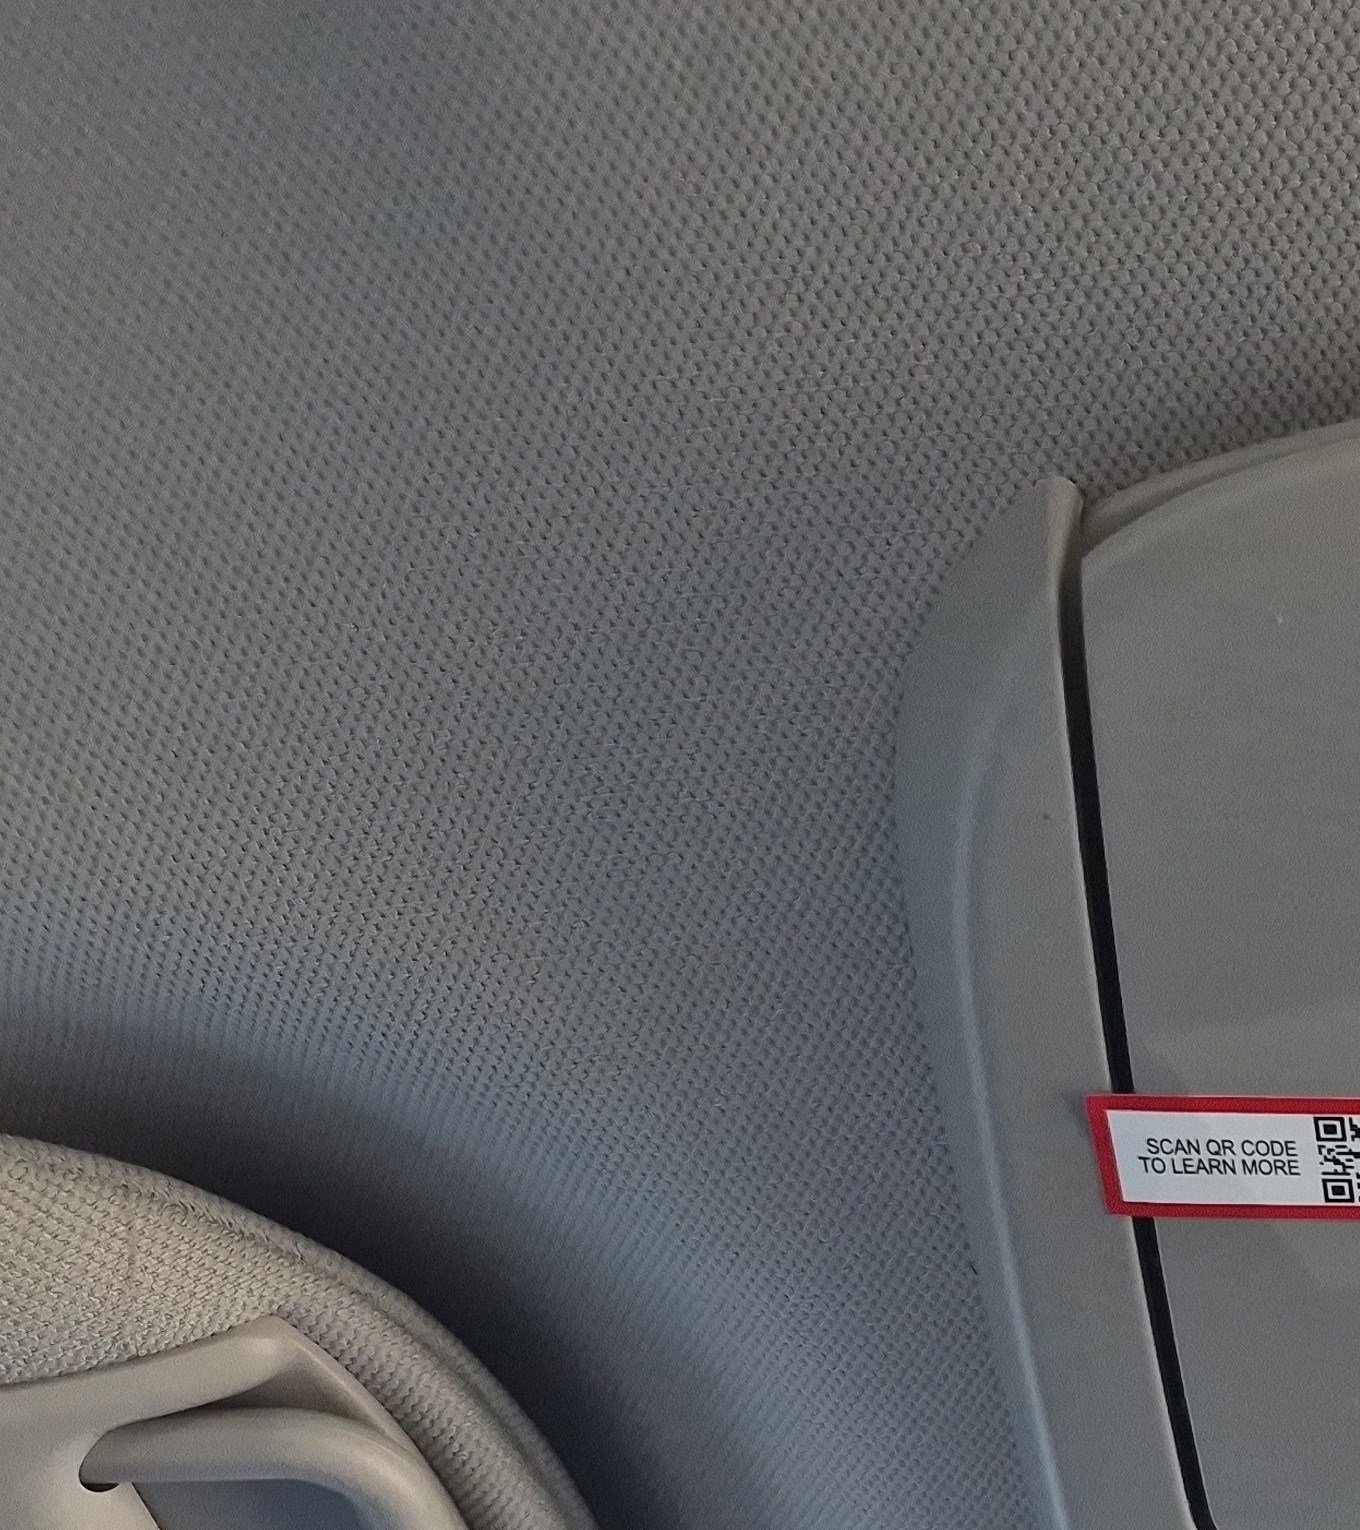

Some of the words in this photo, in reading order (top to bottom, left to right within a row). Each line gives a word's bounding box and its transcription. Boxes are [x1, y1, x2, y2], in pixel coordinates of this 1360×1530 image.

[1146, 1138, 1200, 1156] SCAN
[1206, 1139, 1236, 1157] QR
[1241, 1139, 1299, 1158] CODE
[1138, 1157, 1167, 1175] TO
[1171, 1157, 1237, 1176] LEARN
[1241, 1158, 1301, 1177] MORE
